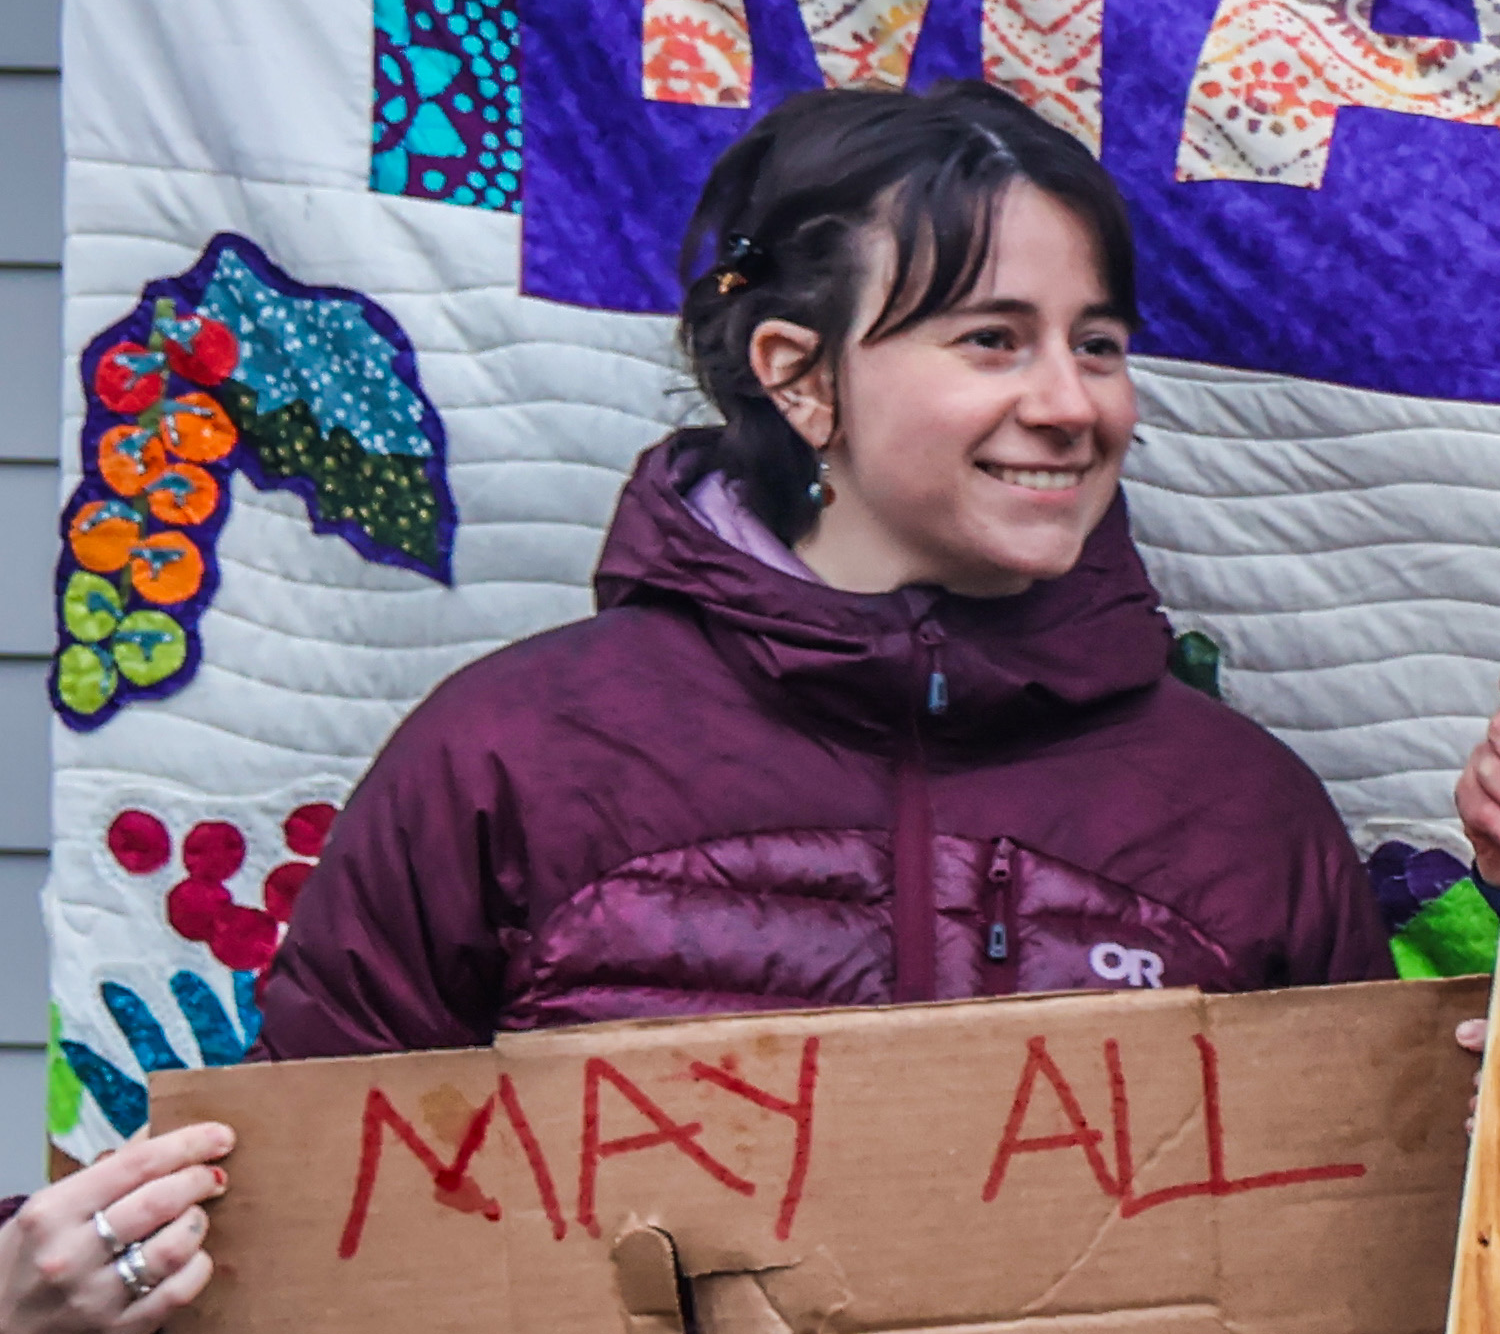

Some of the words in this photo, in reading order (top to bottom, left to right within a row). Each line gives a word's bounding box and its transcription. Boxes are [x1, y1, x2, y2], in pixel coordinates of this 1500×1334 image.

[1089, 942, 1164, 989] OR
[338, 1033, 822, 1263] MAY
[984, 1033, 1368, 1219] ALL
